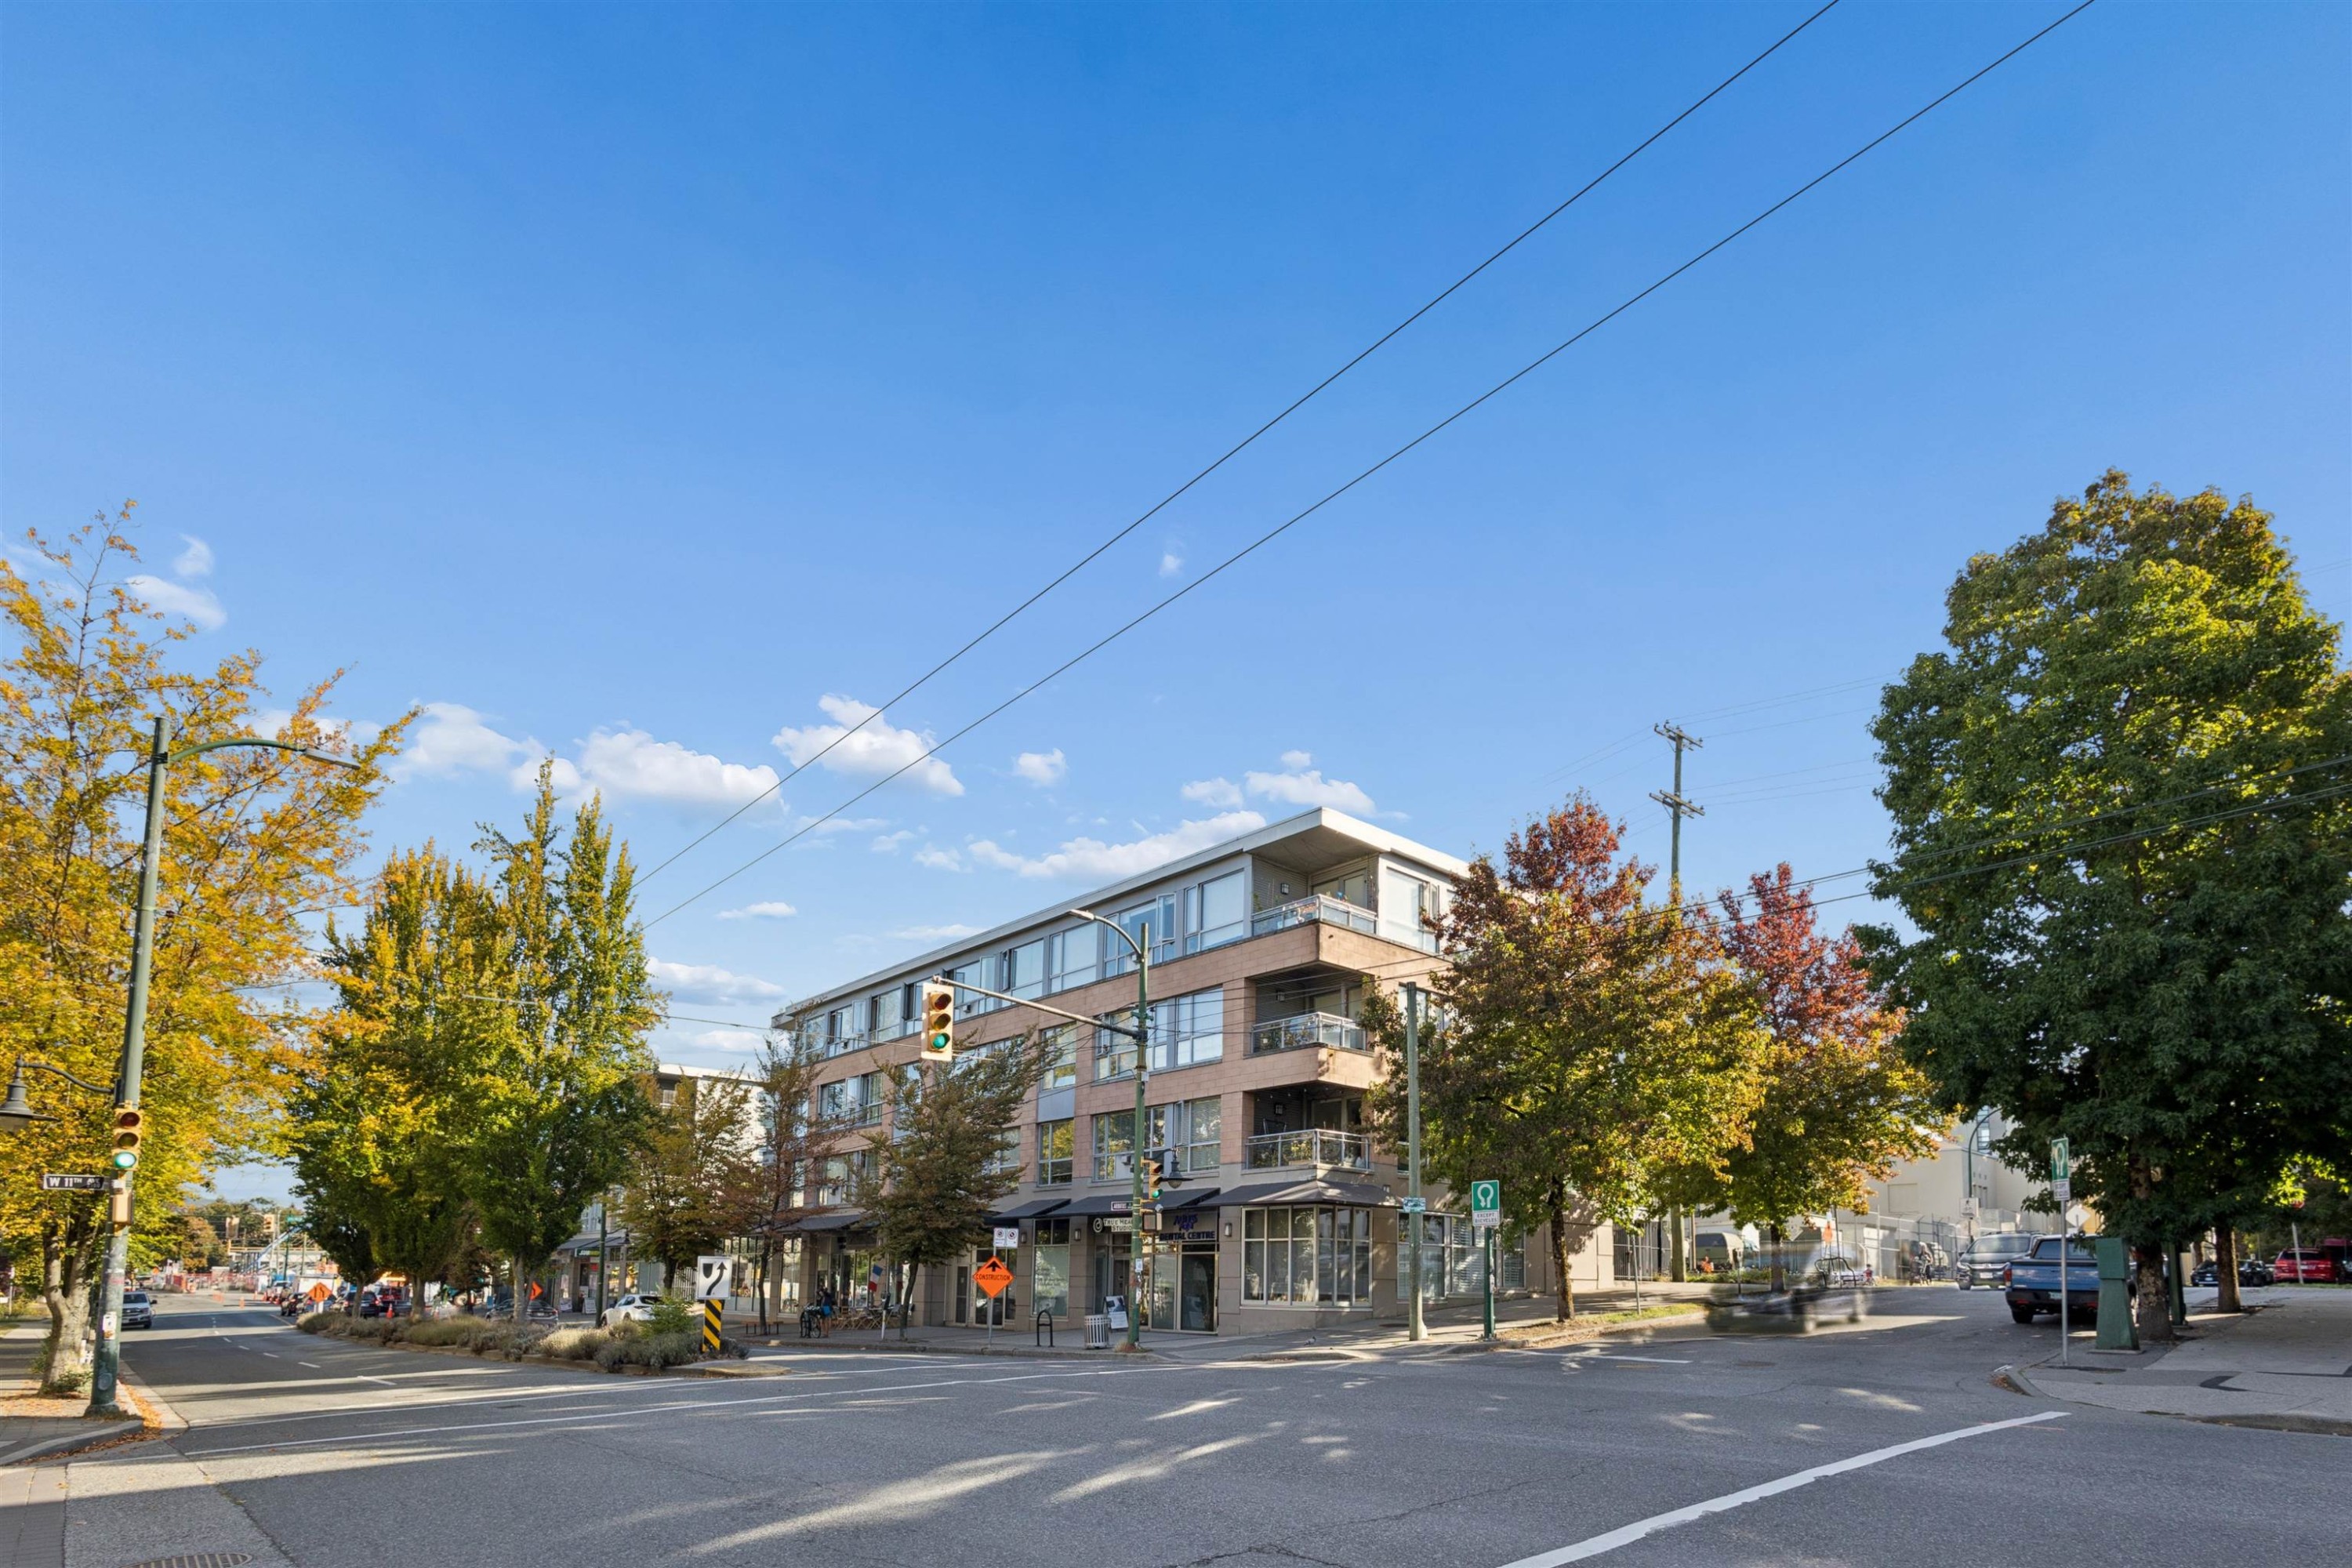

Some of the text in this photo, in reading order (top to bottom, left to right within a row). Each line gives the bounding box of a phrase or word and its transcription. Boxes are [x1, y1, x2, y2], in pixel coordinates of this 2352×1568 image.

[49, 1177, 60, 1187] W
[64, 1178, 83, 1187] 11TH
[1160, 1230, 1215, 1241] DENTAL CENTRE
